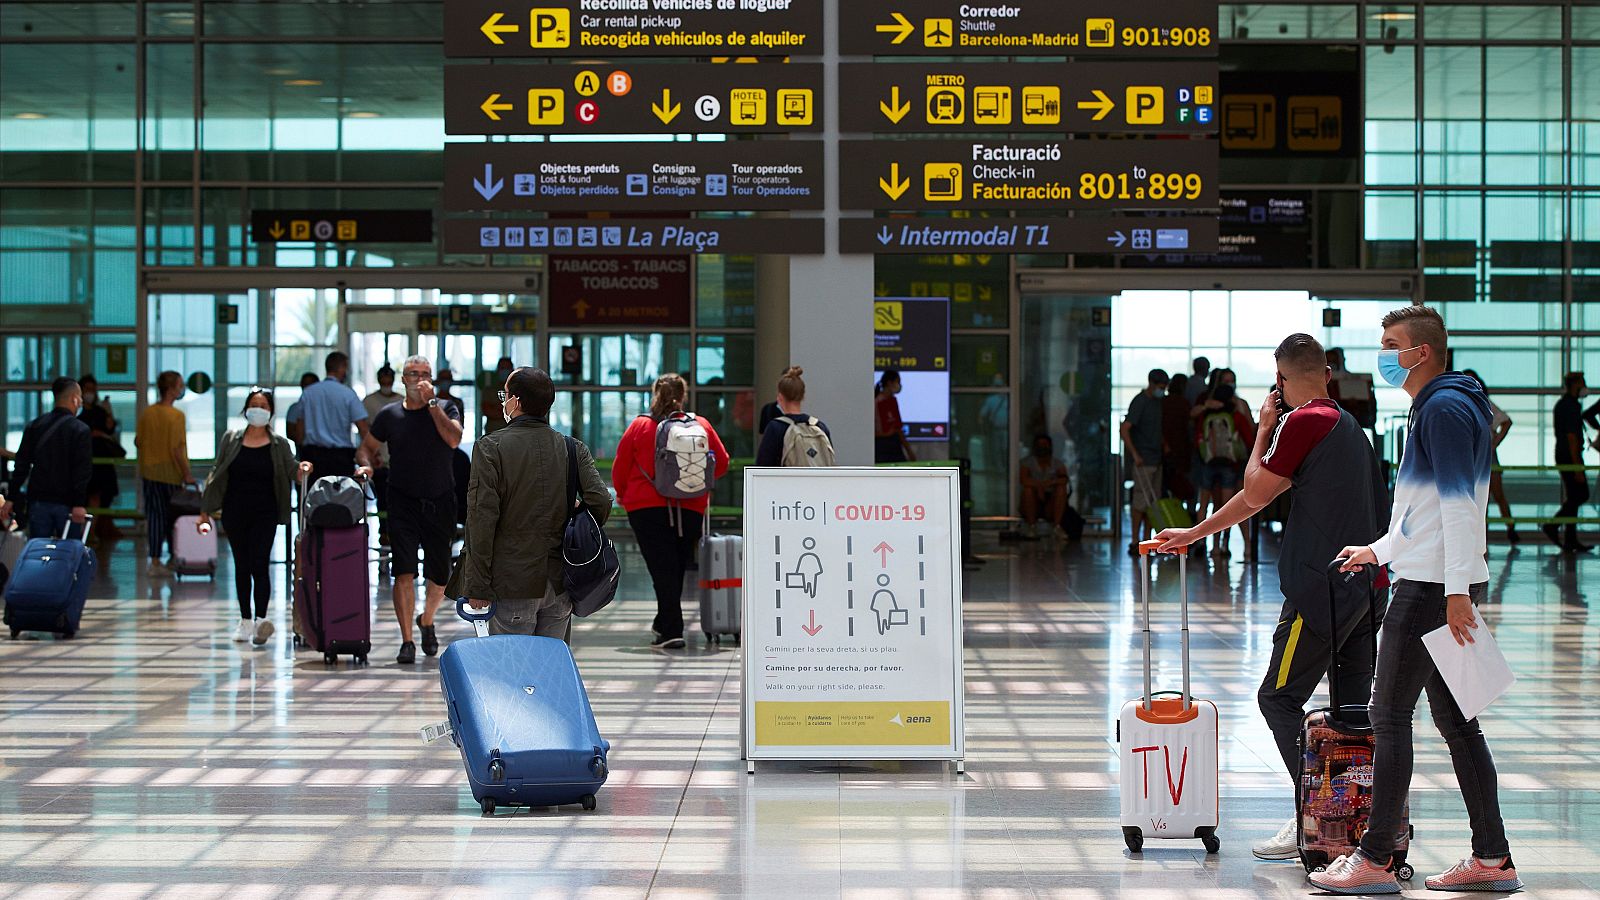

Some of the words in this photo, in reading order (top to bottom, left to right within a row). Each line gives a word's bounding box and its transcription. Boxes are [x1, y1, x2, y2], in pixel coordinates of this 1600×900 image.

[581, 0, 648, 10] Recollida
[717, 0, 735, 10] de
[740, 0, 792, 12] lloguer
[960, 5, 1020, 17] Corredor
[581, 15, 600, 27] Car
[605, 15, 637, 27] rental
[641, 15, 681, 29] pick-up
[960, 20, 995, 31] Shuttle
[581, 31, 649, 48] Recogida
[654, 31, 722, 46] vehículos
[728, 31, 745, 46] de
[751, 31, 805, 48] alquiler
[960, 34, 1079, 46] Barcelona-Madrid
[1122, 27, 1161, 46] 901
[1170, 27, 1211, 46] 908
[580, 75, 594, 92] A
[613, 76, 627, 93] B
[926, 75, 965, 86] METRO
[733, 92, 764, 100] HOTEL
[1179, 88, 1190, 102] D
[579, 103, 594, 122] C
[700, 98, 714, 117] G
[1180, 108, 1189, 121] F
[1199, 108, 1208, 121] E
[973, 144, 1061, 161] Facturació
[540, 163, 582, 175] Objectes
[584, 164, 620, 175] perduts
[652, 164, 696, 175] Consigna
[732, 164, 754, 174] Tour
[757, 164, 804, 175] operadors
[973, 165, 1035, 179] Check-in
[1133, 165, 1147, 179] to
[540, 175, 558, 183] Lost
[560, 175, 567, 183] &
[568, 175, 592, 184] found
[652, 175, 668, 184] Left
[670, 175, 702, 186] luggage
[732, 175, 750, 183] Tour
[752, 175, 790, 186] operators
[540, 185, 577, 197] Objetos
[579, 185, 620, 197] perdidos
[652, 185, 696, 197] Consigna
[732, 185, 754, 195] Tour
[756, 185, 811, 197] Operadores
[973, 182, 1071, 200] Facturación
[1080, 173, 1131, 200] 801
[1149, 173, 1202, 200] 899
[1135, 187, 1144, 200] a
[628, 227, 653, 247] La
[662, 226, 719, 252] Plaça
[901, 226, 1018, 246] Intermodal
[1026, 226, 1049, 246] T1
[553, 259, 619, 273] TABACOS
[632, 259, 687, 273] TABACS
[580, 276, 659, 290] TOBACCOS
[623, 307, 669, 318] METROS
[771, 500, 816, 521] info
[834, 504, 926, 521] COVID-19
[765, 645, 790, 653] Camini
[792, 647, 805, 655] per
[807, 645, 815, 653] la
[765, 664, 796, 672] Camine
[825, 664, 861, 673] derecha,
[880, 664, 904, 672] favor.
[817, 683, 836, 692] right
[837, 683, 856, 691] side,
[858, 683, 886, 692] please.
[905, 715, 932, 724] aena
[1131, 745, 1188, 806] TV
